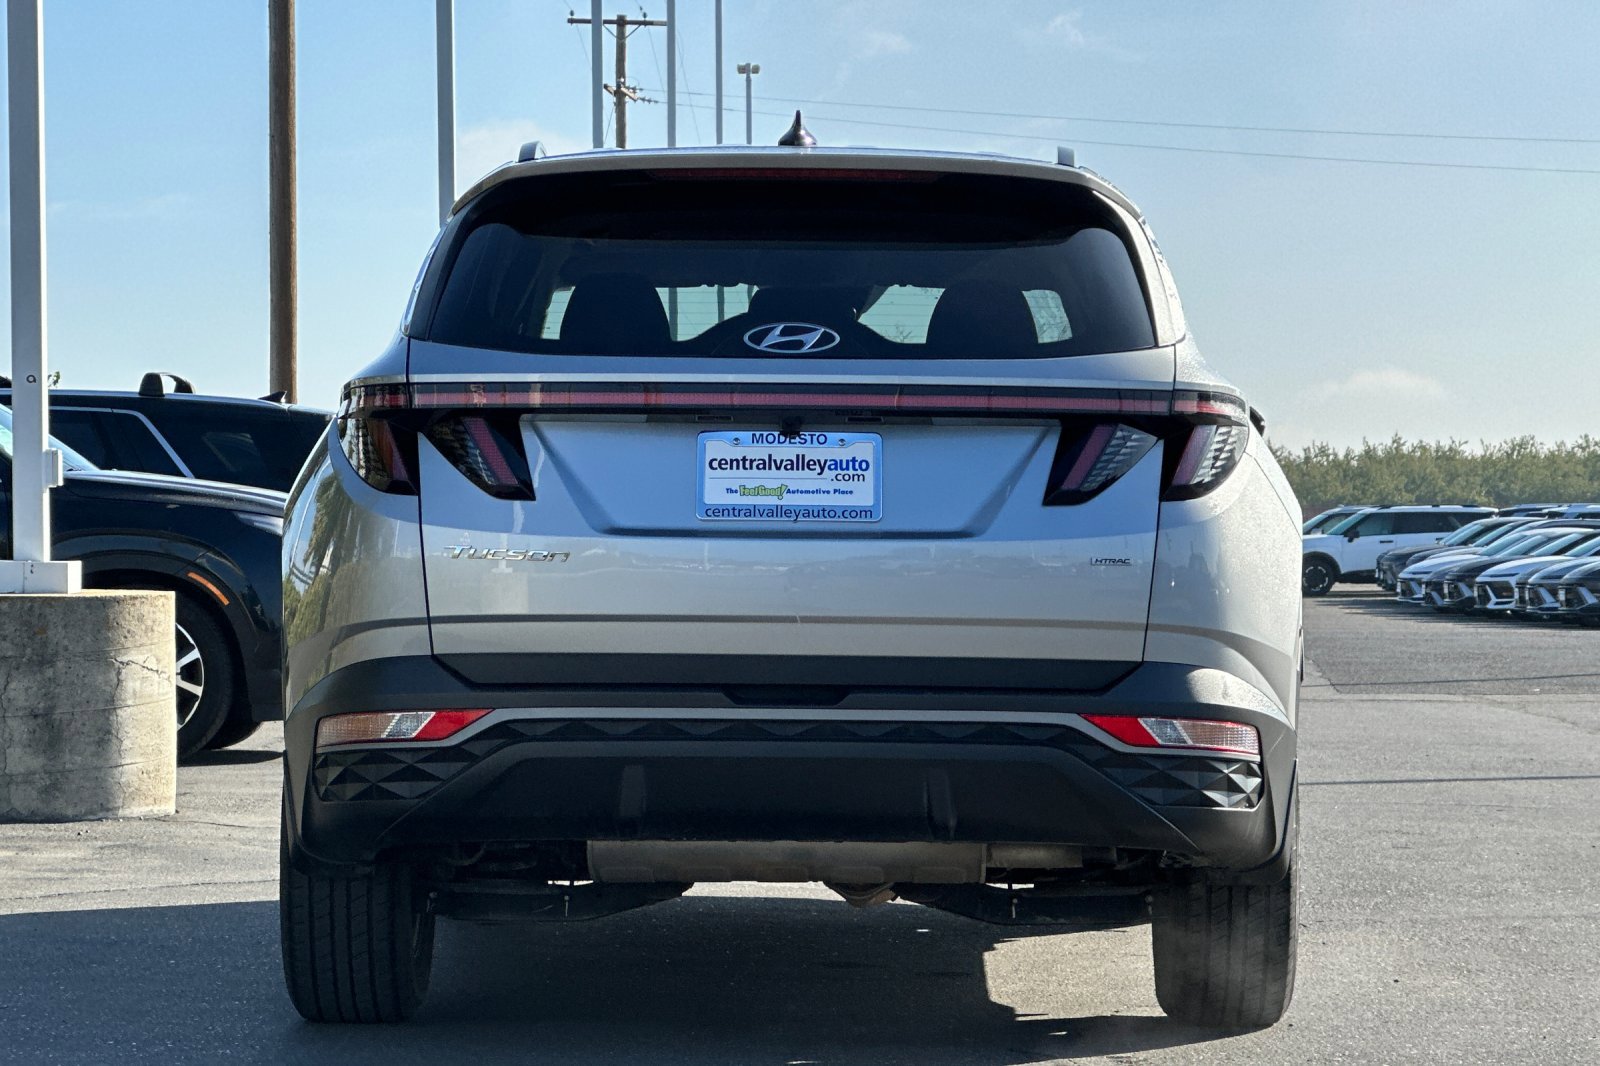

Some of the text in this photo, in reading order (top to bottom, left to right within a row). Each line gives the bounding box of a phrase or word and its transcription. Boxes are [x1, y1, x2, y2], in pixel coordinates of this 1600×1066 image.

[751, 433, 828, 445] MODESTO
[708, 454, 870, 475] centralvalleyauto
[830, 473, 865, 482] .com
[705, 505, 873, 521] centralvalleyauto.com
